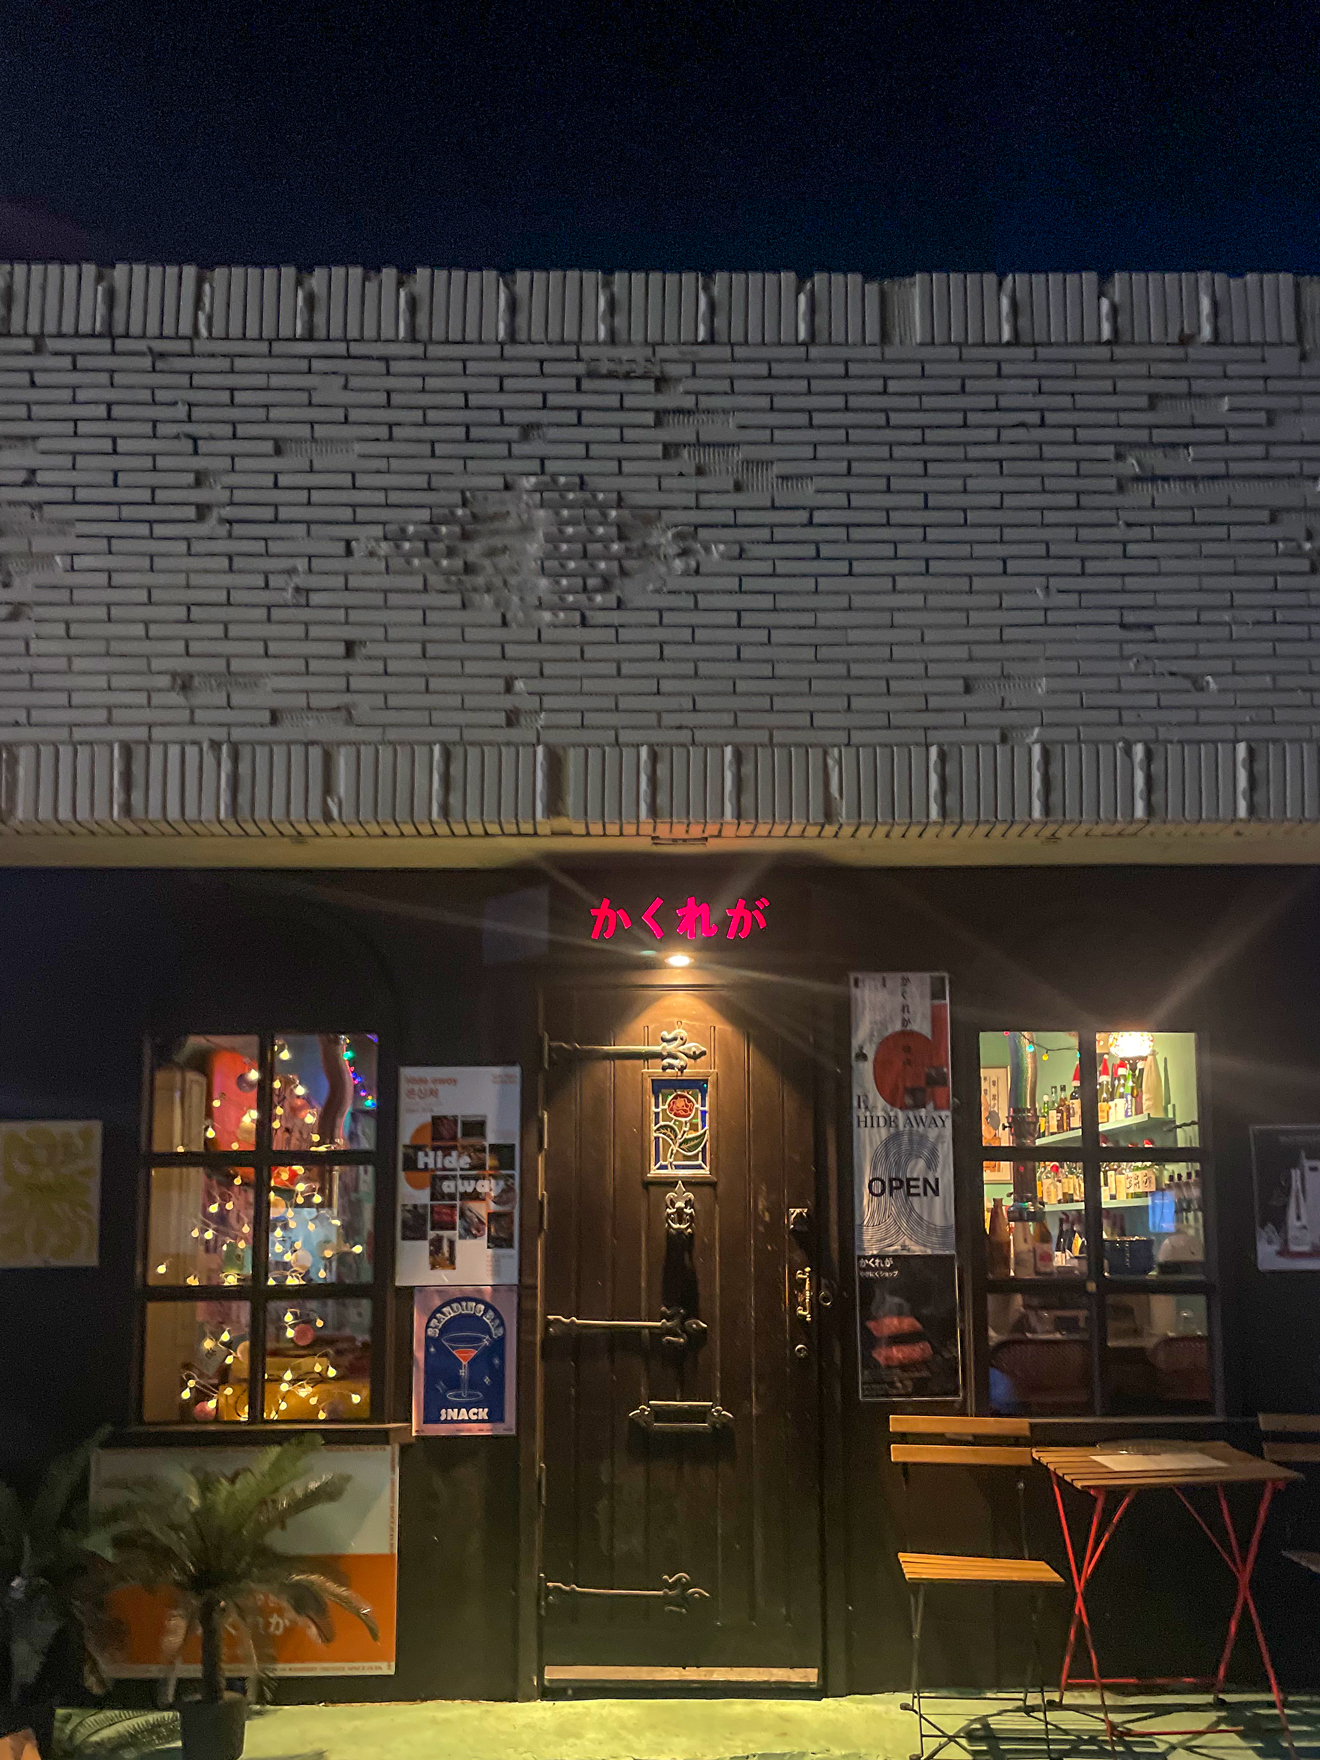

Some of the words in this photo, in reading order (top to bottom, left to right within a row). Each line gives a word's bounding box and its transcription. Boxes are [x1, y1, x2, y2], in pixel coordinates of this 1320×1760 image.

[590, 897, 770, 939] かくれが
[857, 1115, 898, 1128] HIDE
[904, 1115, 949, 1128] AWAY
[417, 1150, 471, 1168] Hide
[442, 1176, 505, 1200] away
[868, 1177, 940, 1197] OPEN
[859, 1257, 894, 1268] かくれが
[427, 1301, 485, 1338] STANDING
[440, 1408, 489, 1420] SNACK
